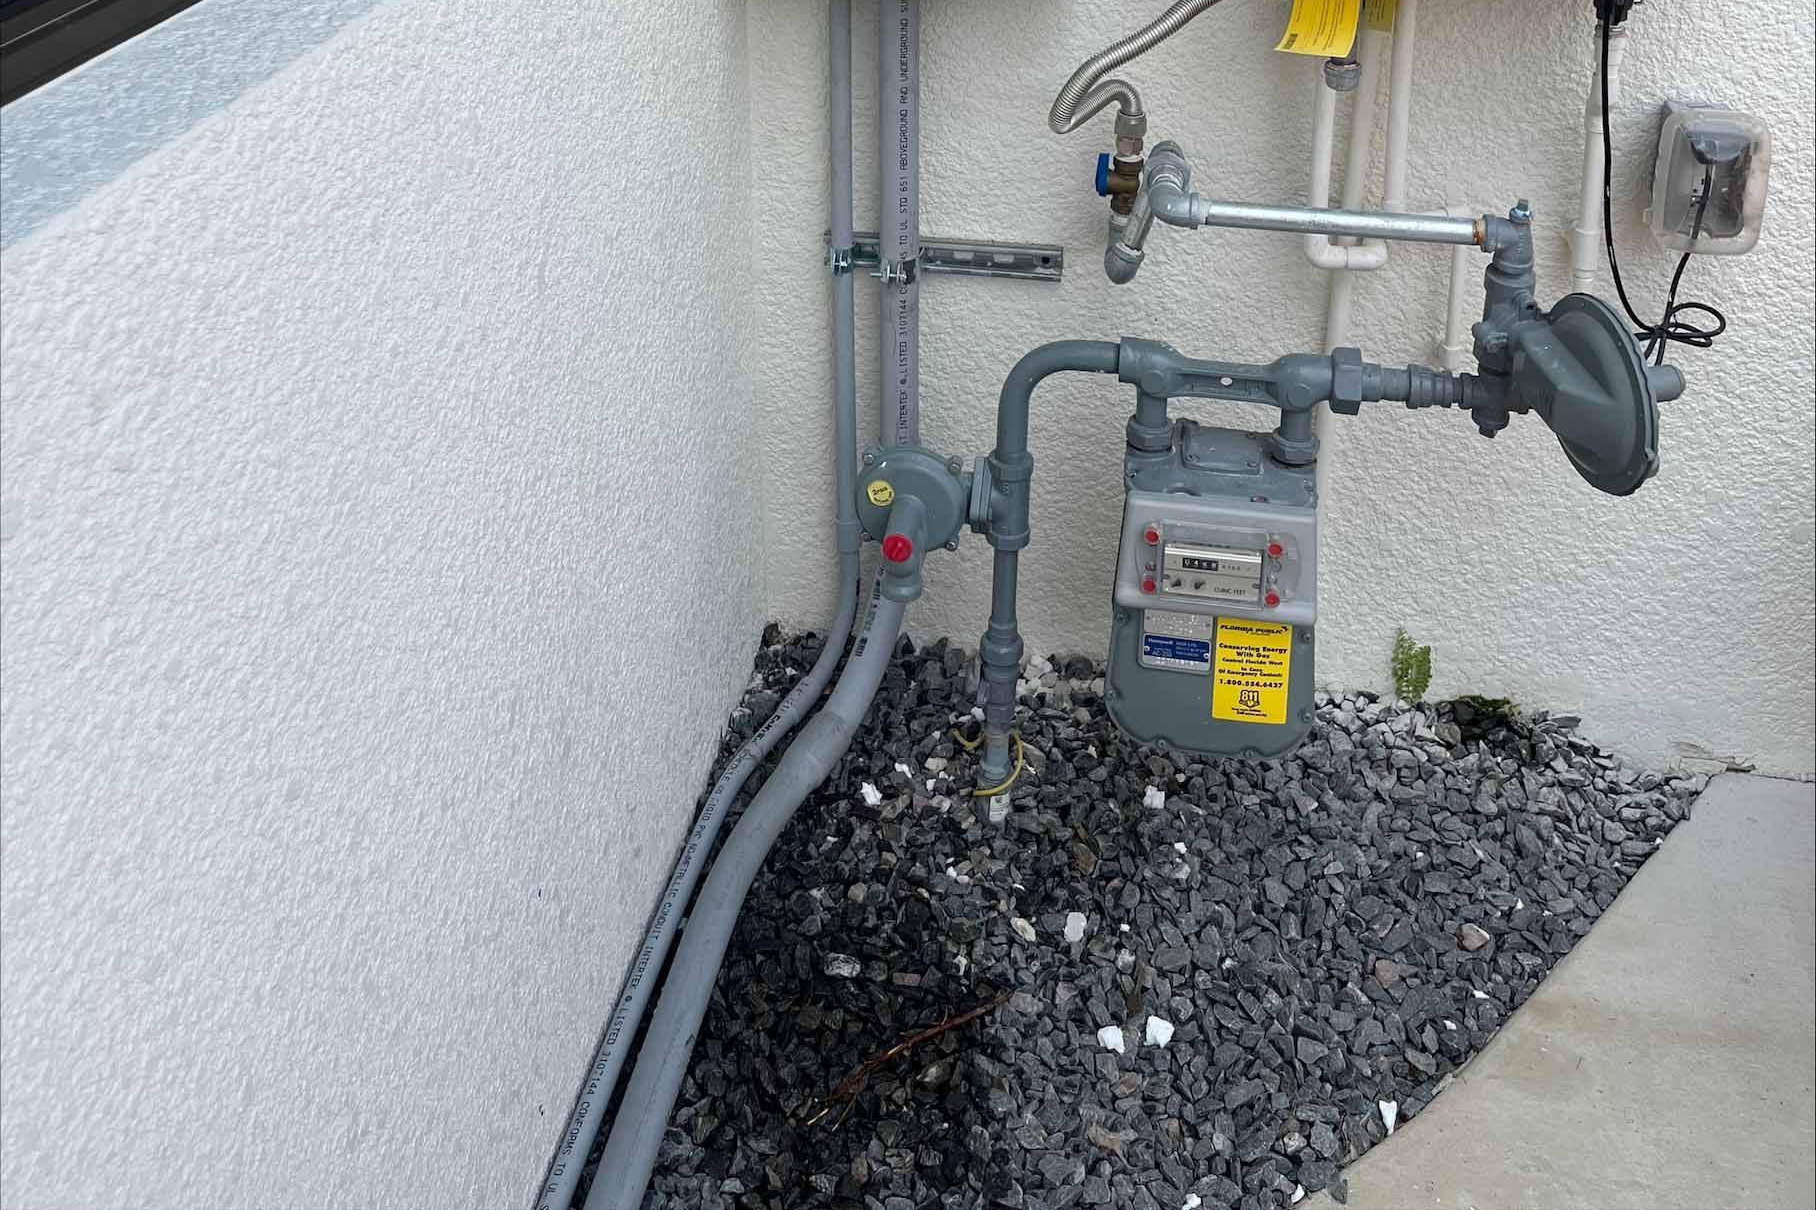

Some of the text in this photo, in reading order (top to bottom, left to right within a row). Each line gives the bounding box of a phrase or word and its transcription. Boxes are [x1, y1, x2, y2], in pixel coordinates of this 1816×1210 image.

[900, 18, 908, 82] UNDERGROUND
[900, 86, 908, 104] AND
[900, 109, 908, 170] ABOVEGROUND
[900, 176, 908, 192] 651
[899, 197, 908, 214] STD
[899, 341, 908, 373] LISTED
[899, 390, 908, 429] INTERTEK
[1219, 642, 1288, 654] Conserving Energy
[1241, 690, 1258, 702] 811
[607, 1007, 629, 1045] LISTED
